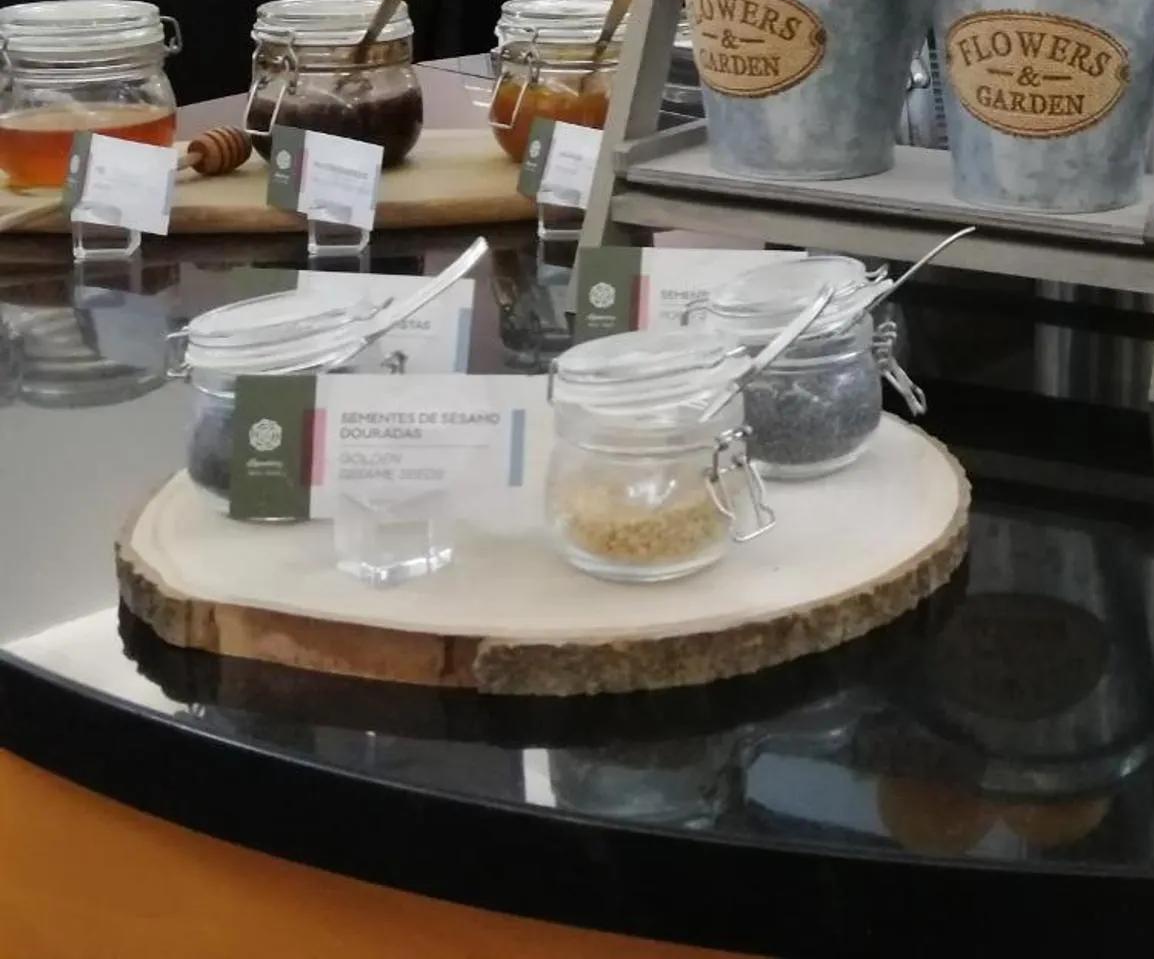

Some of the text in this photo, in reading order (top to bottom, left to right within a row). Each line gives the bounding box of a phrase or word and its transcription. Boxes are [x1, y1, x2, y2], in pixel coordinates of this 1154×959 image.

[721, 28, 740, 49] &
[700, 47, 781, 77] ARDEN
[957, 31, 1112, 77] FLOWERS
[1017, 65, 1041, 87] &
[976, 85, 1085, 116] GARDEN
[340, 412, 415, 424] SEMENTES
[418, 413, 438, 424] DE
[339, 427, 422, 439] DOURADAS
